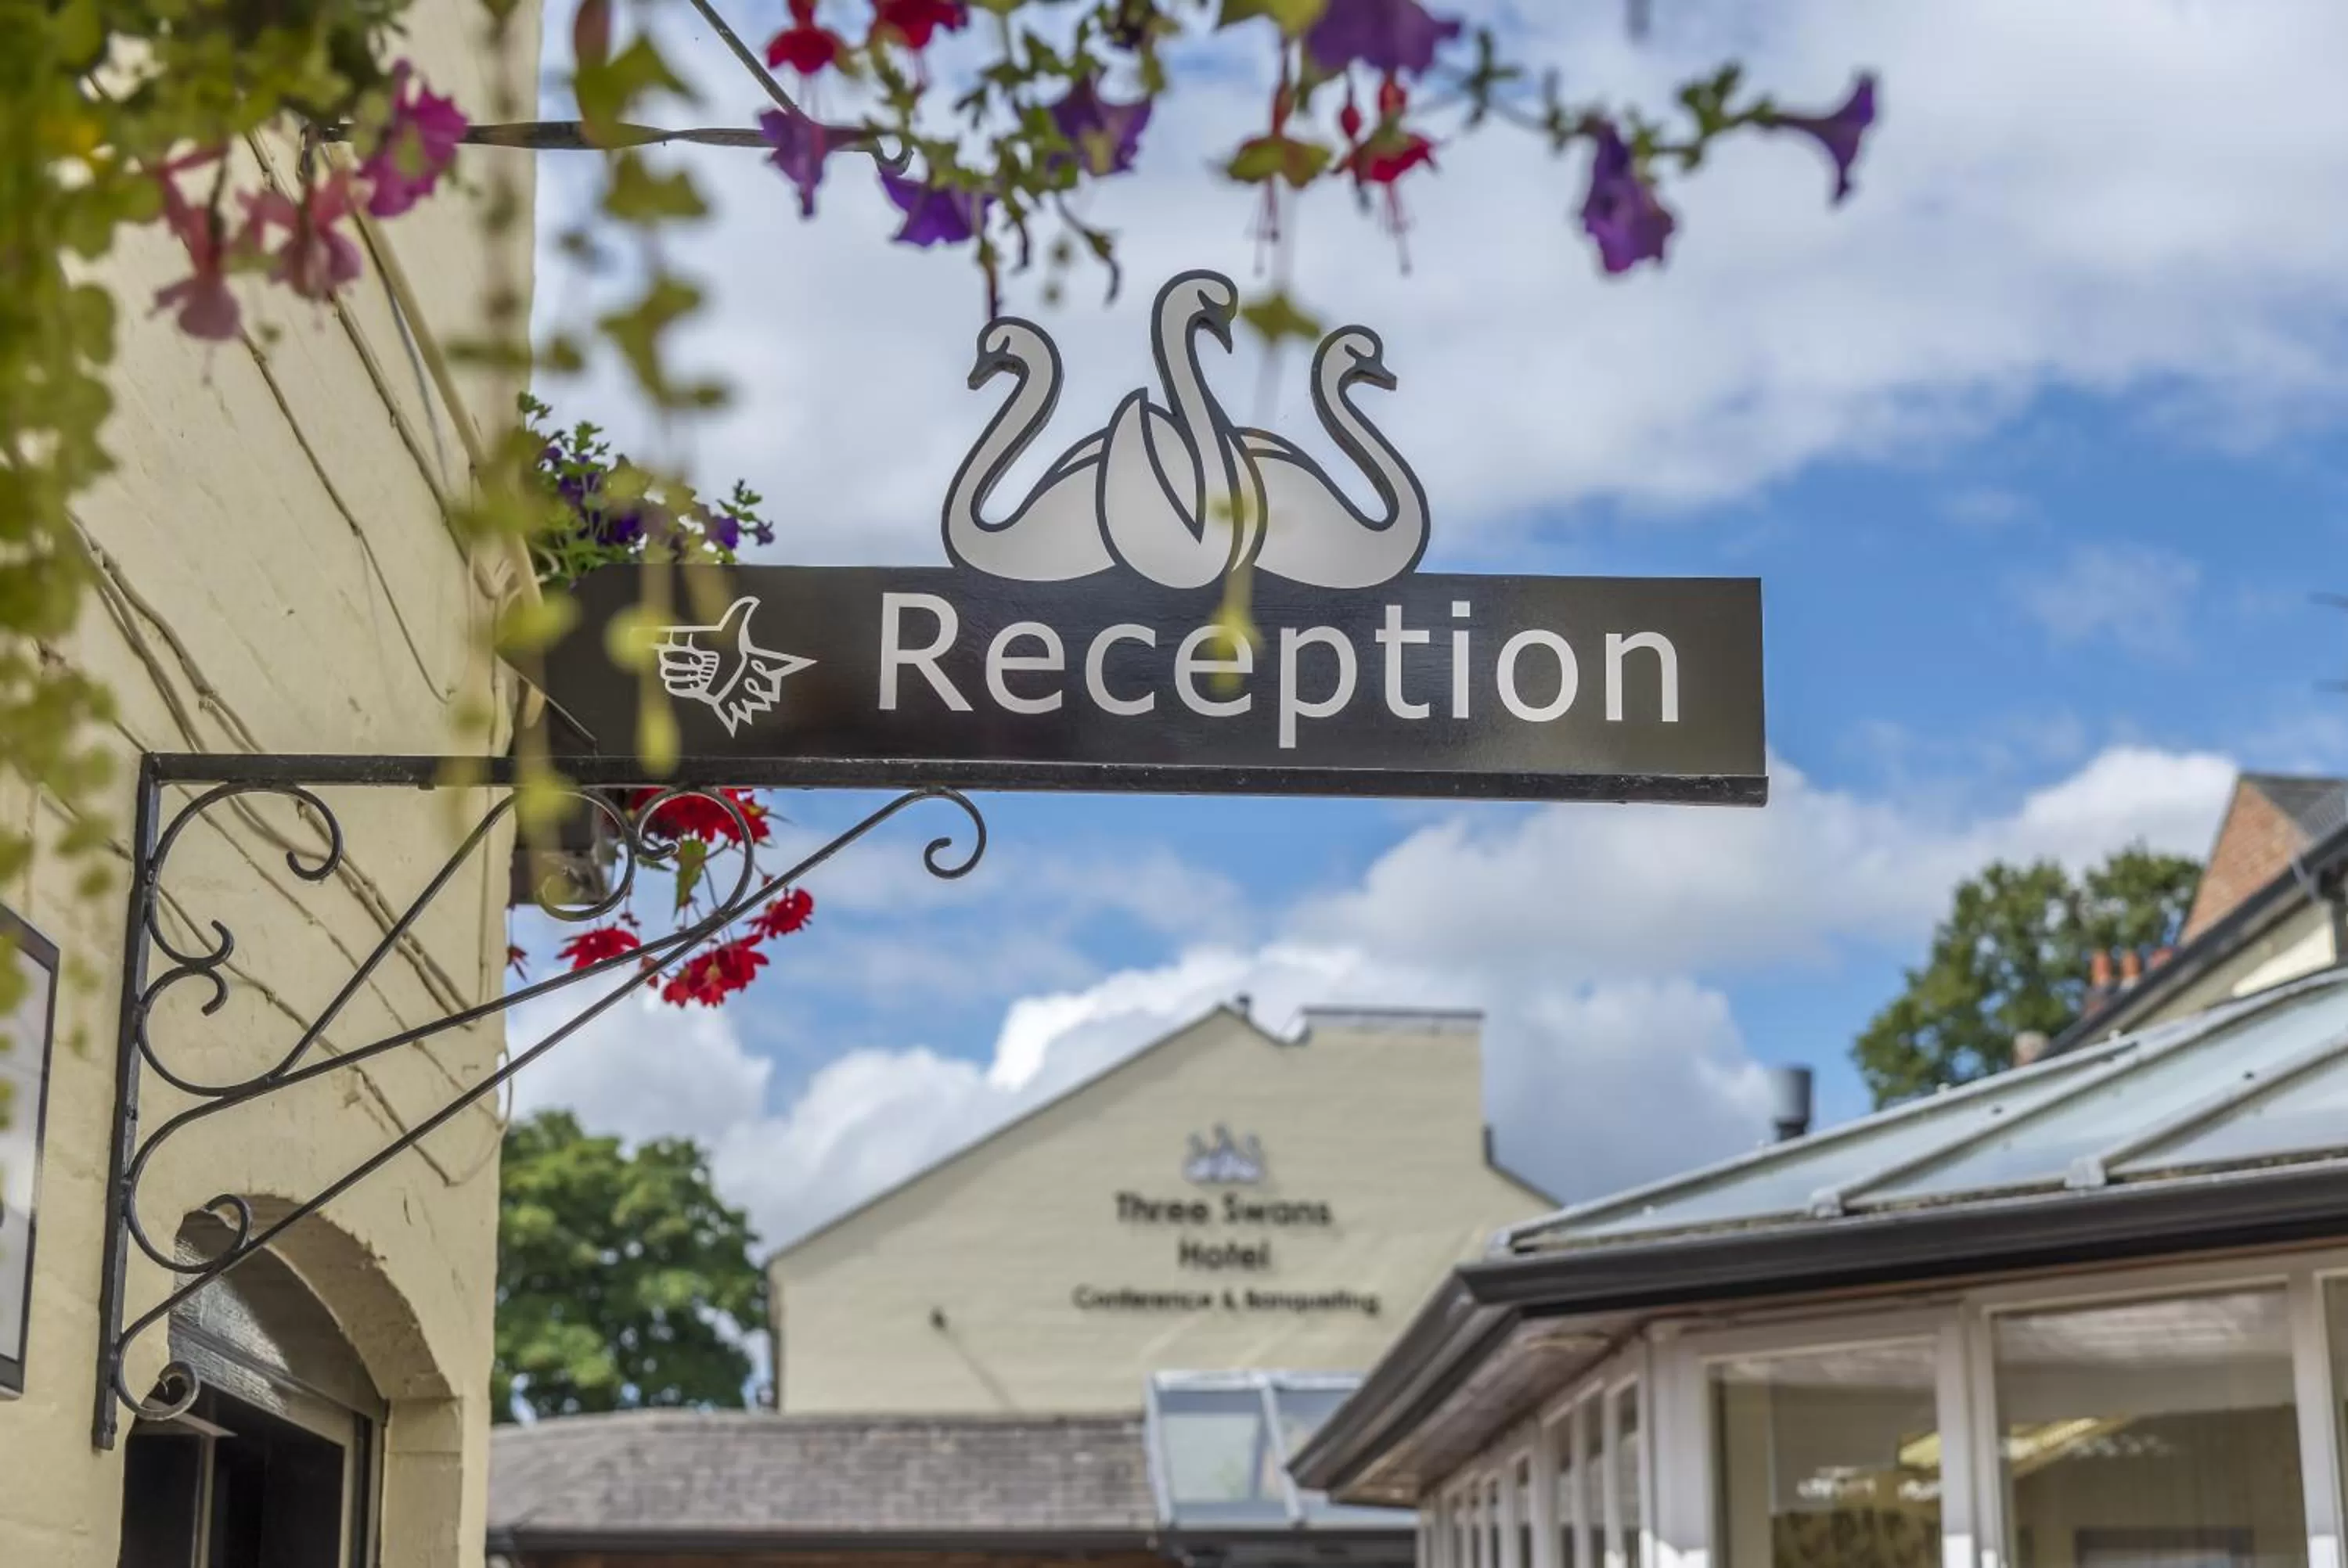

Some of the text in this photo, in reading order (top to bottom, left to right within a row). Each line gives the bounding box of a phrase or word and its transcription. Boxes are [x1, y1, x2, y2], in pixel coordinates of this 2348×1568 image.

[877, 592, 1680, 749] Reception
[1115, 1191, 1332, 1226] Three Swans
[1177, 1237, 1271, 1270] Hotel
[1071, 1283, 1212, 1311] Conference
